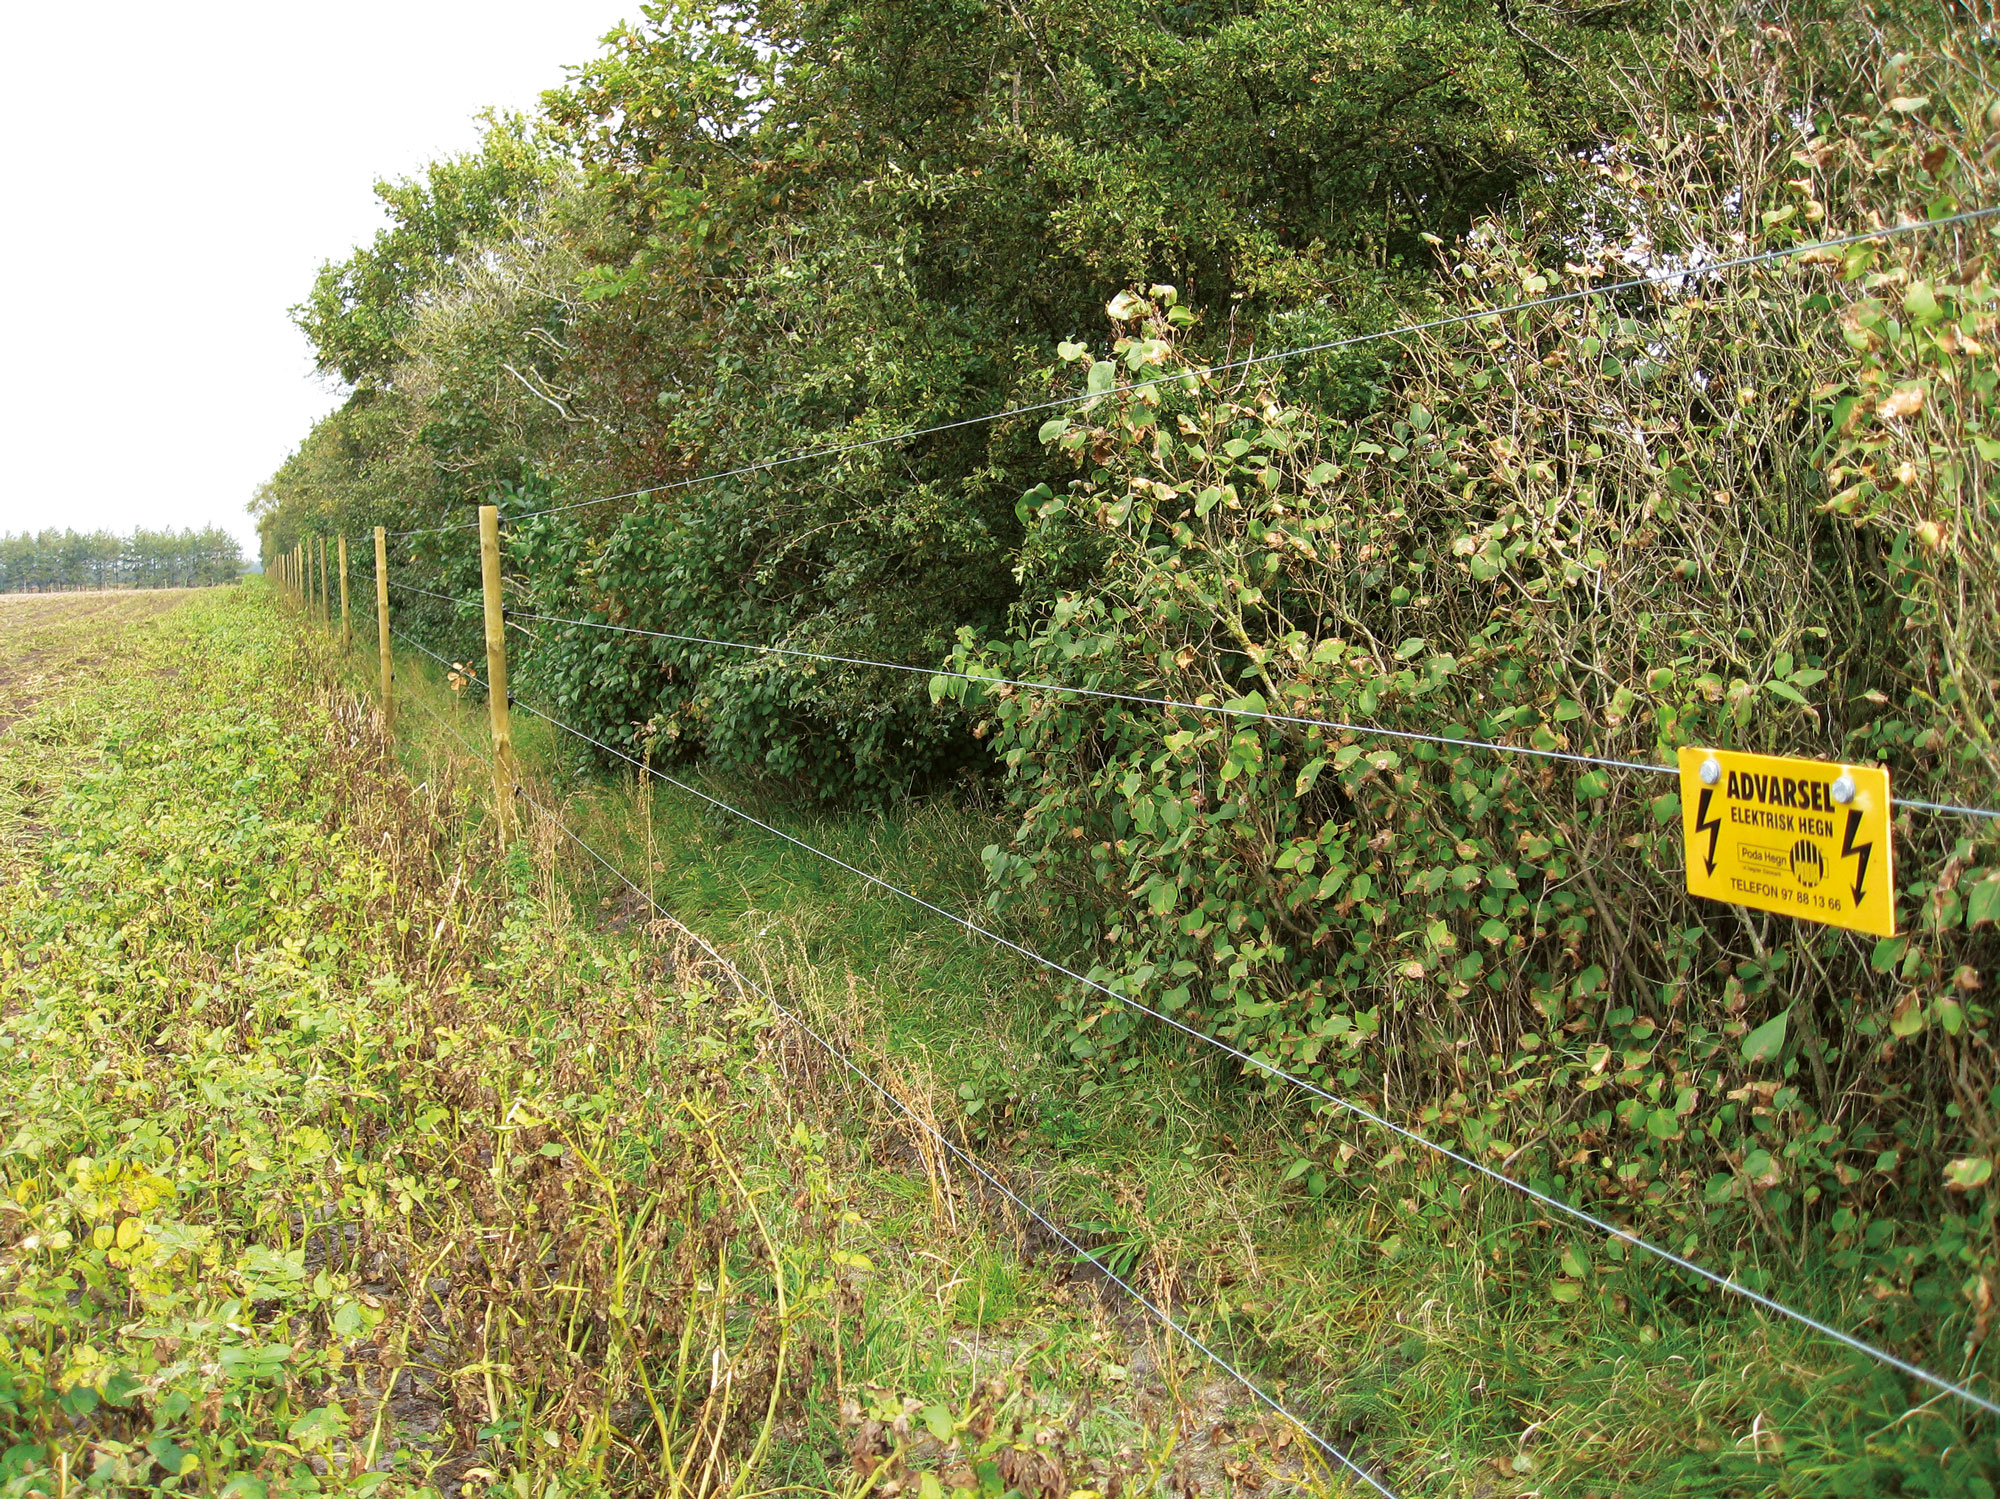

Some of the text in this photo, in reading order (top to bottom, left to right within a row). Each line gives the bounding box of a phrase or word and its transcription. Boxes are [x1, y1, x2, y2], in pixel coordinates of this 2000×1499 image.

[1727, 770, 1835, 813] ADVARSEL
[1731, 806, 1833, 838] ELEKTRISK HEGN
[1742, 847, 1787, 866] Poda Hegn
[1730, 878, 1841, 911] TELEFON 97 88 13 66
